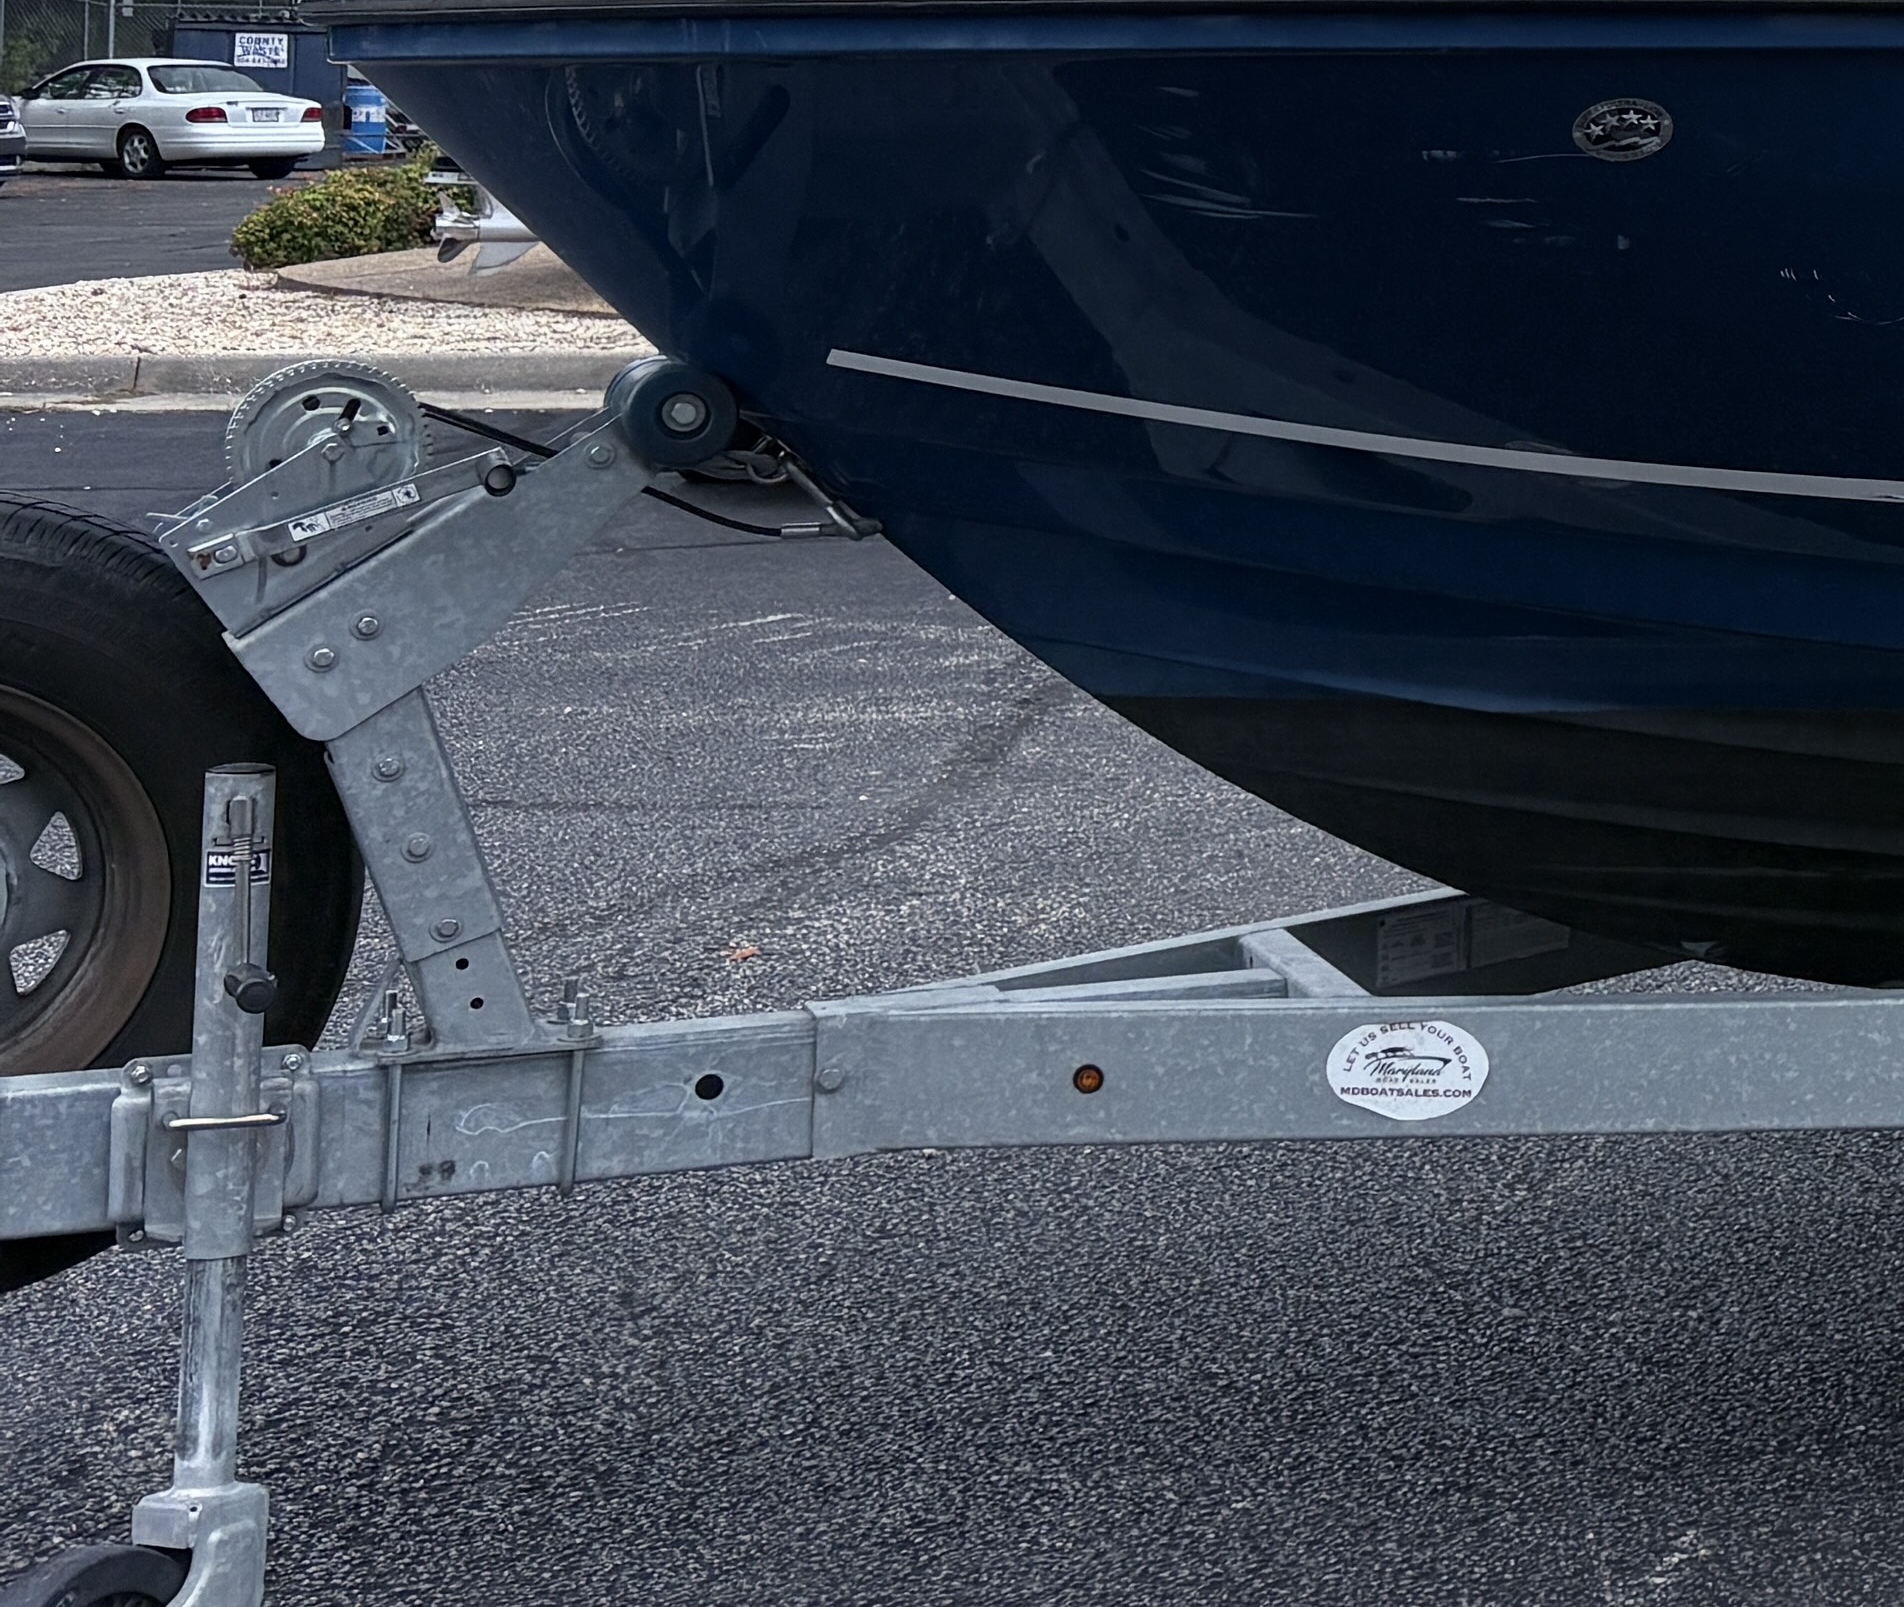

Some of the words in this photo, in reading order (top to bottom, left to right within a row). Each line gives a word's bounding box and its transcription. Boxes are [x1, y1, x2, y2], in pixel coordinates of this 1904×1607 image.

[239, 36, 284, 45] COUNTY
[1342, 1047, 1360, 1073] LET
[1359, 1031, 1377, 1047] US
[1380, 1022, 1416, 1034] SELL
[1420, 1022, 1454, 1045] YOUR
[1453, 1046, 1472, 1081] BOAT
[1340, 1086, 1472, 1098] MDBOATSALES.COM
